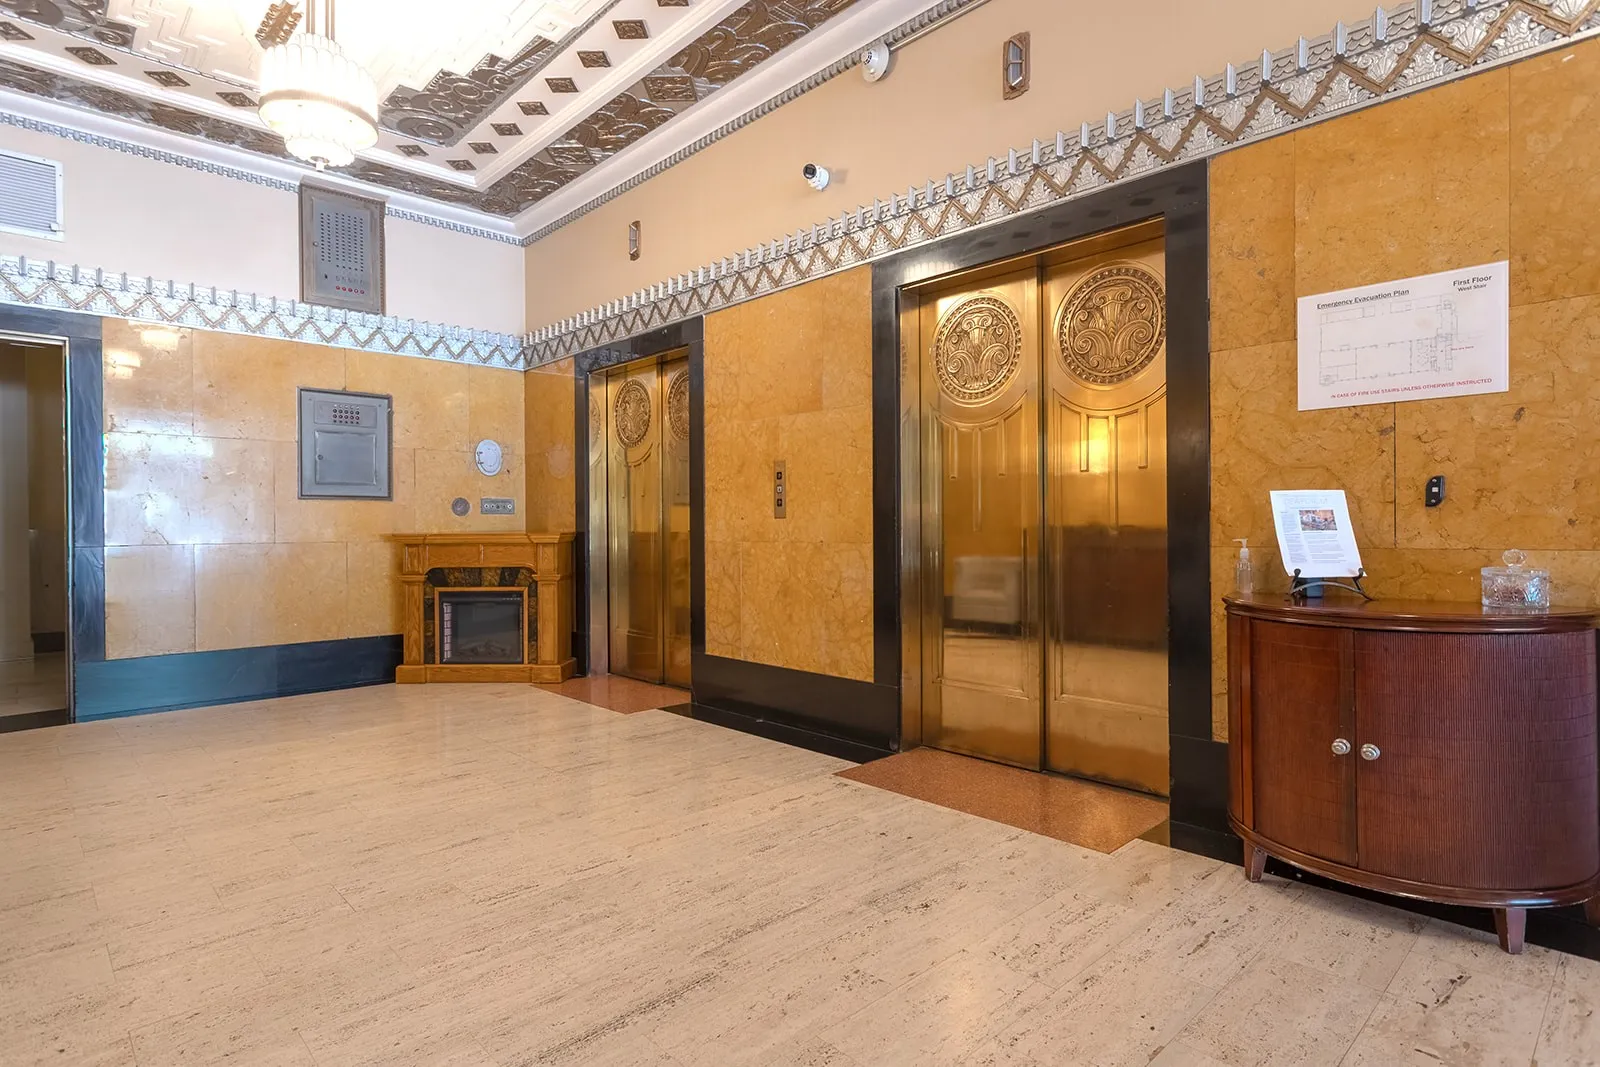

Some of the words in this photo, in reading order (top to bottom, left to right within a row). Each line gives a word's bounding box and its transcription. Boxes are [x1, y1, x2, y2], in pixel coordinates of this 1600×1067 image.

[1453, 278, 1470, 286] First
[1472, 275, 1492, 283] Floor
[1317, 298, 1353, 310] Emergency
[1354, 292, 1392, 303] Evacuation
[1393, 288, 1410, 297] Plan
[1422, 381, 1455, 390] OTHERWISE
[1456, 378, 1492, 386] INSTRUCTED
